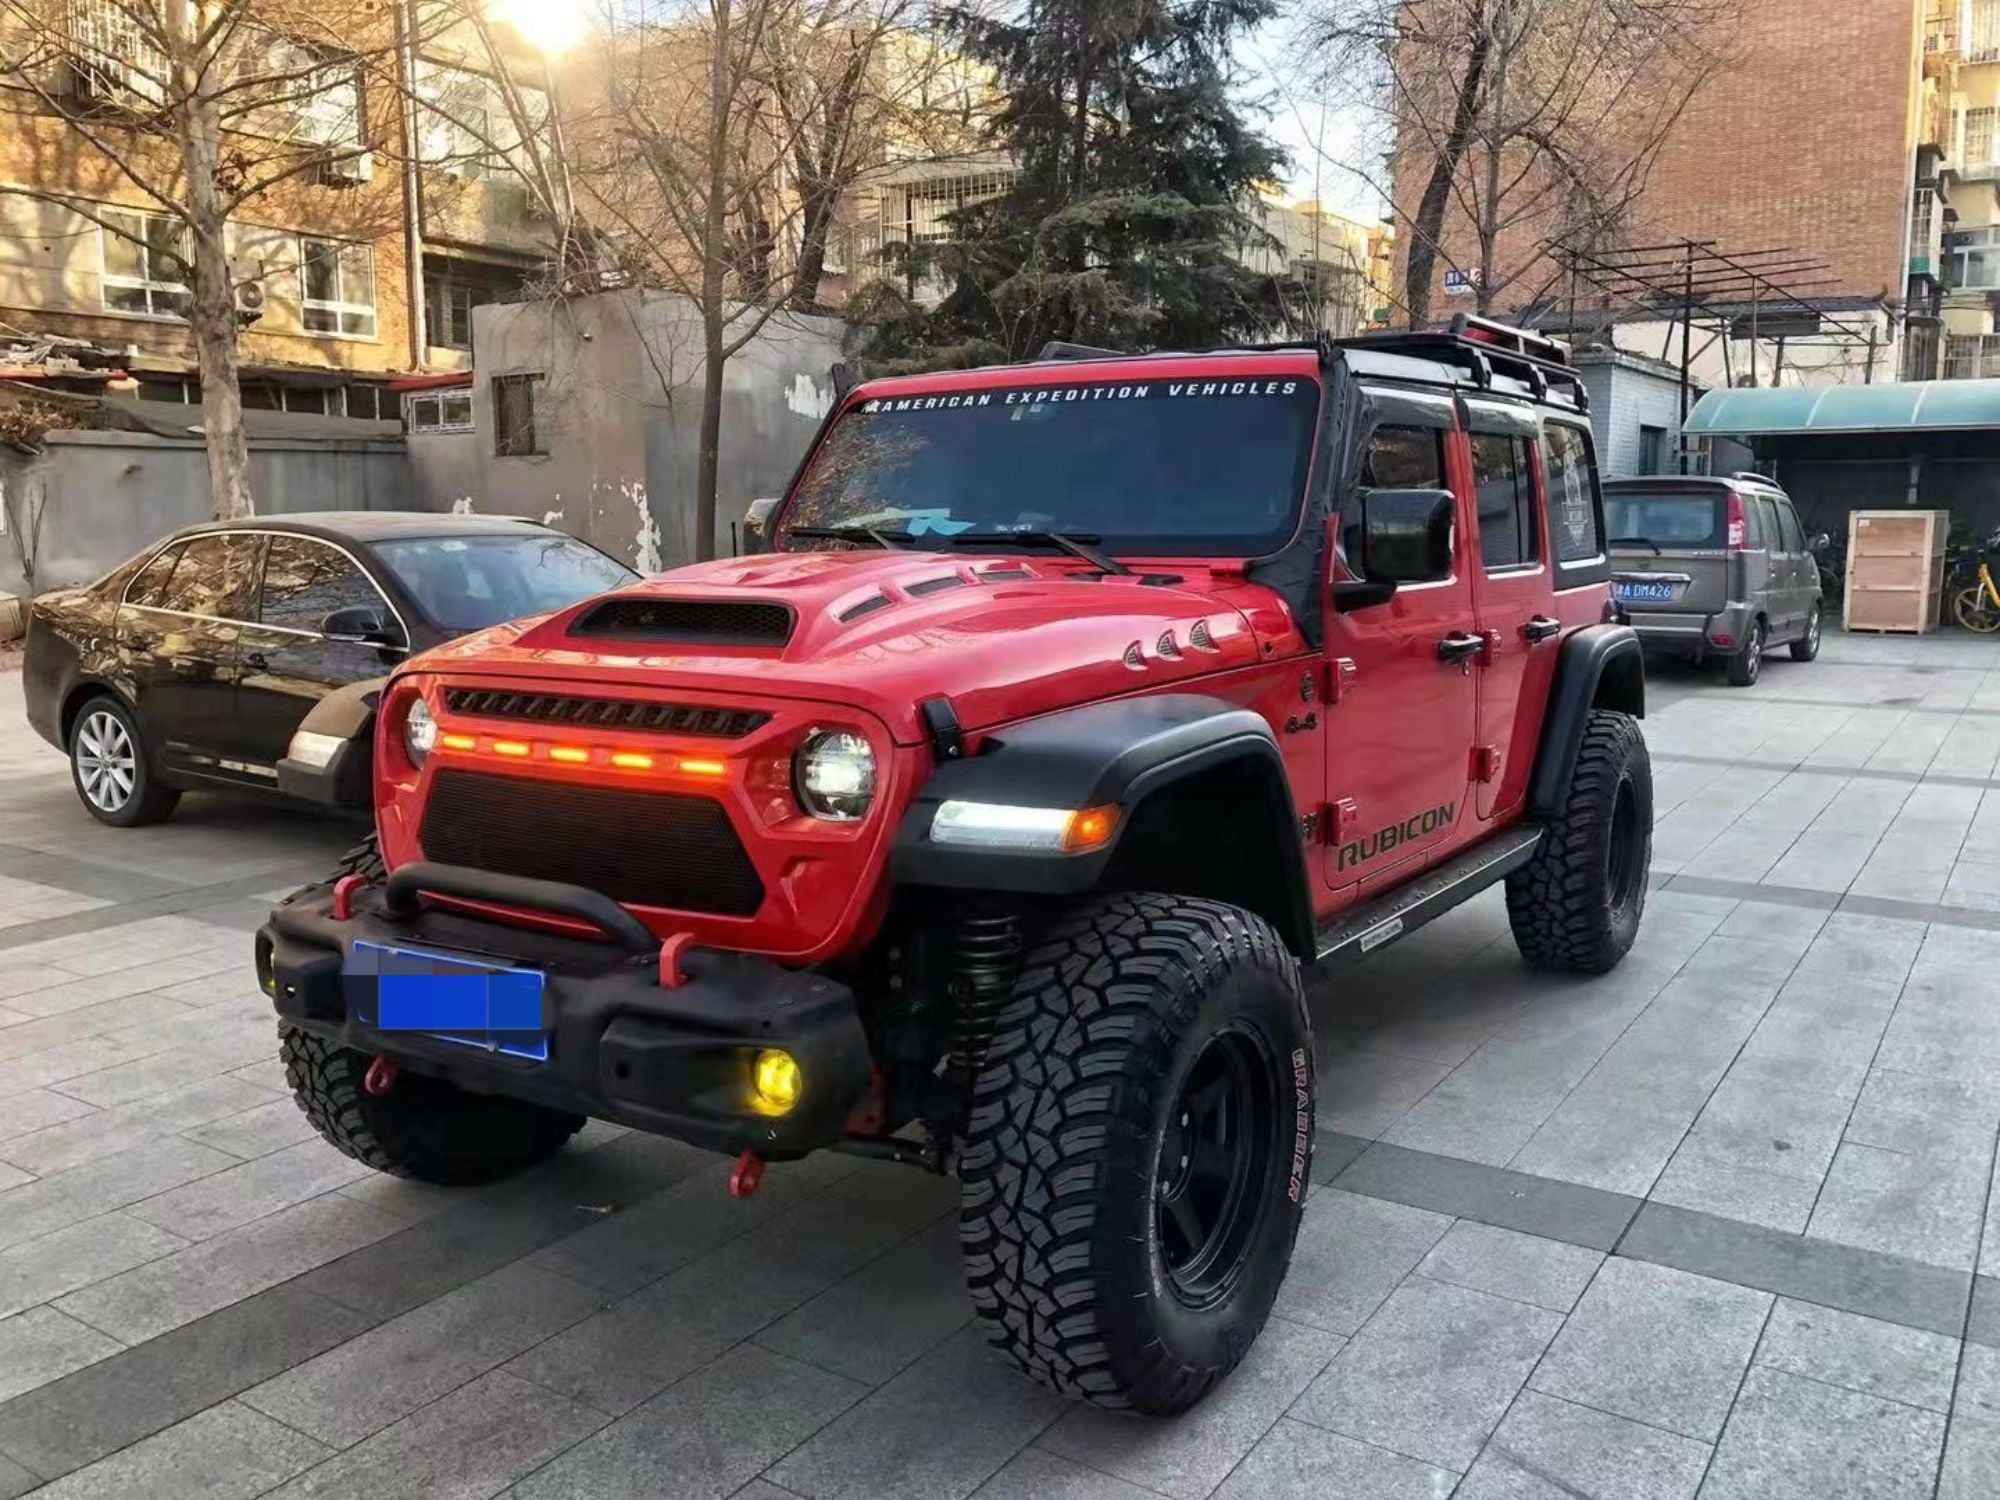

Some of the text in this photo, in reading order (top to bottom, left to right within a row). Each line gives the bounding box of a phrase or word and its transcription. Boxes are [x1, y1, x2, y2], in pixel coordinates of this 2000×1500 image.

[881, 382, 1297, 413] AMERICAN EXPEDITION VEHICLES
[1337, 801, 1455, 873] RUBICON
